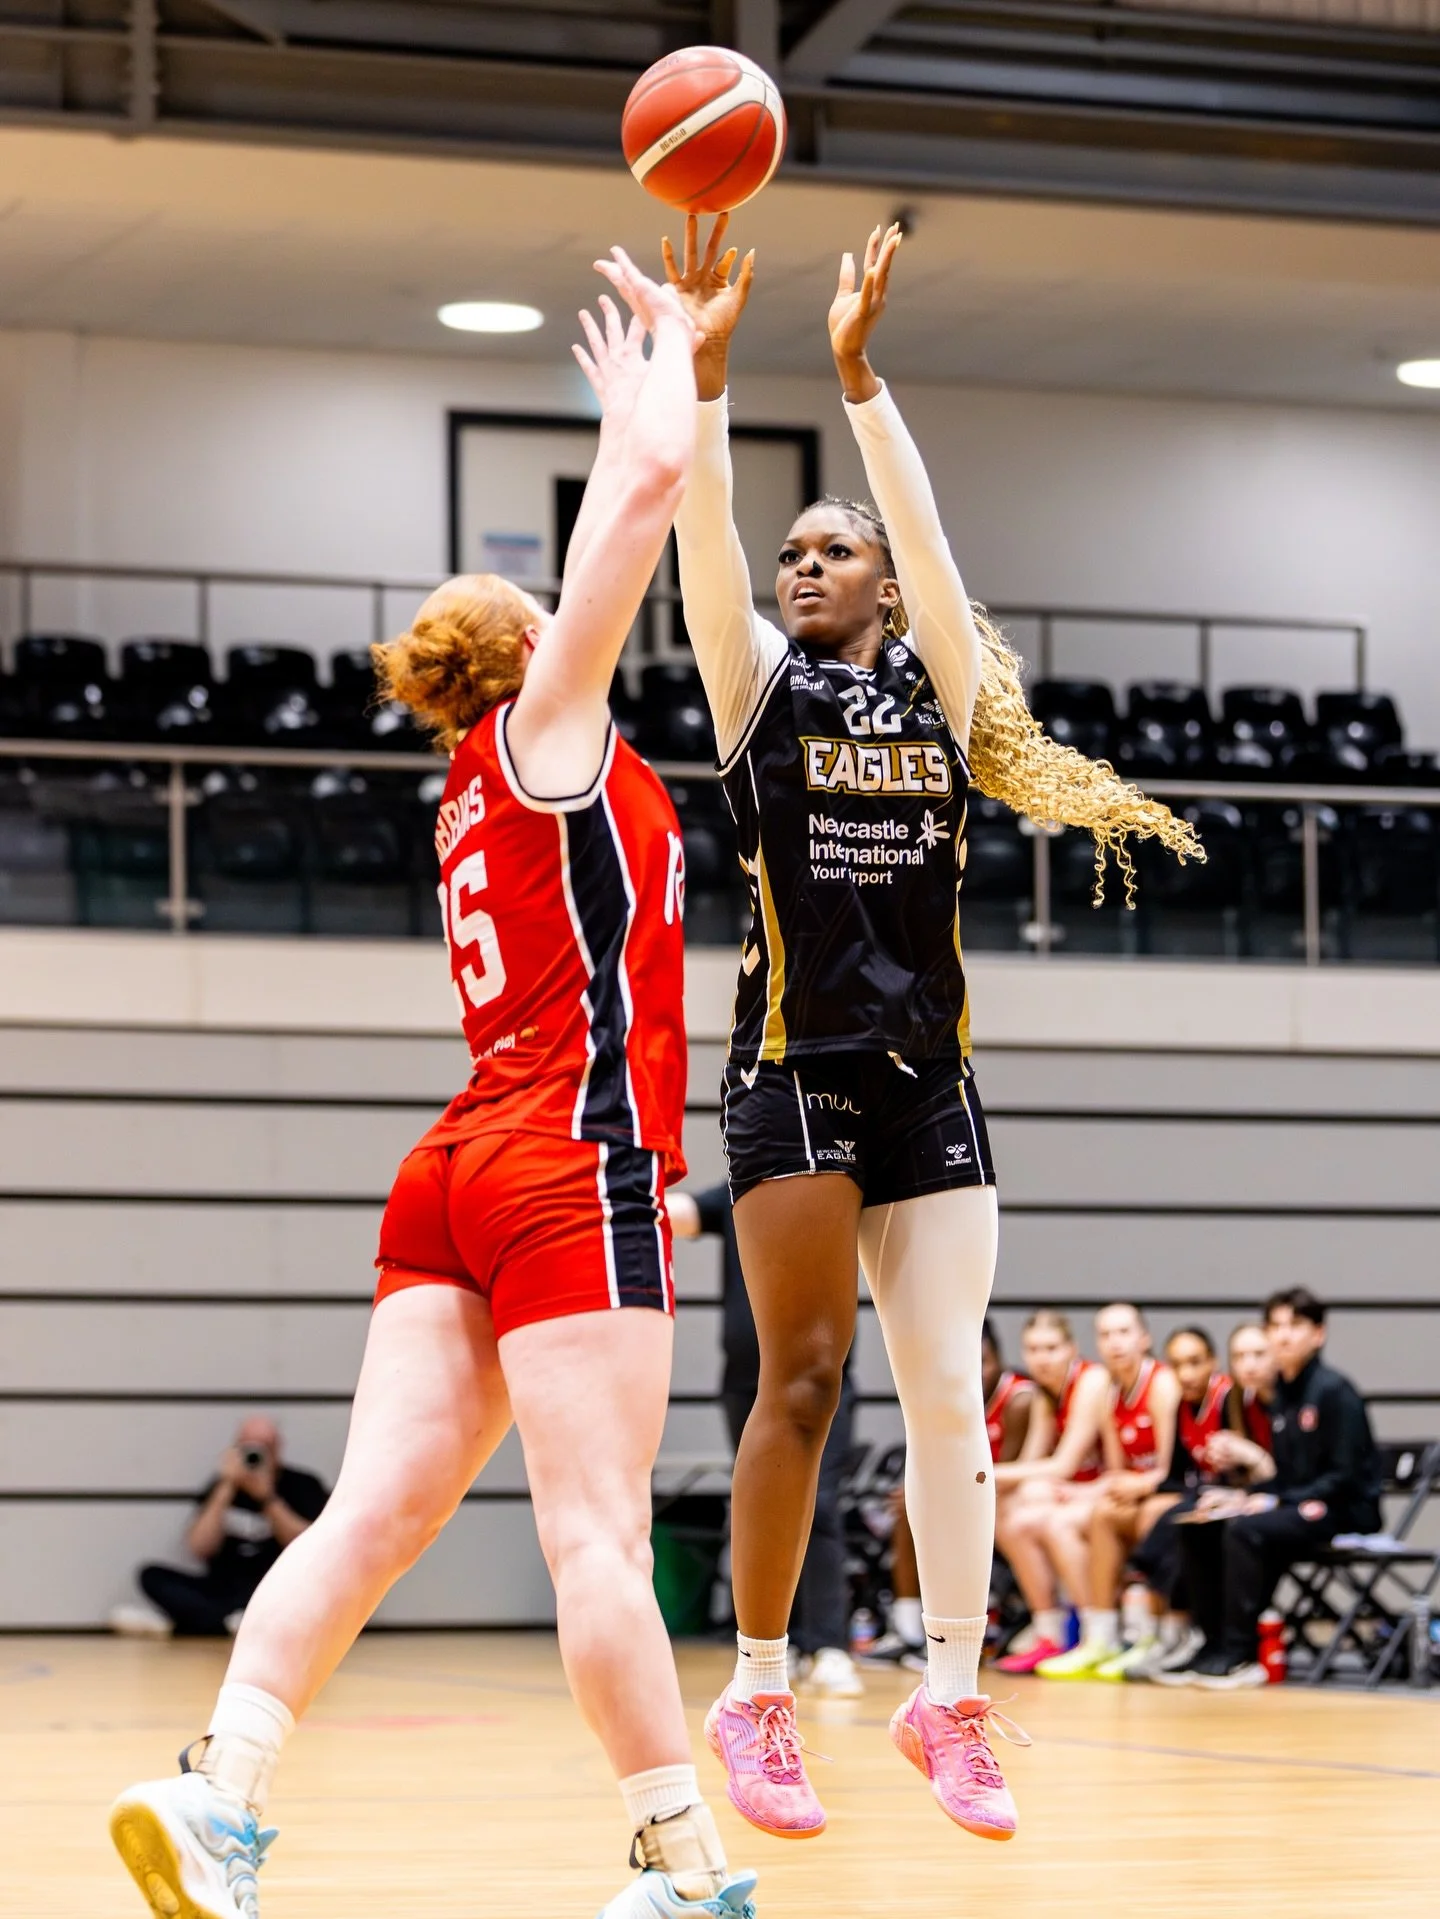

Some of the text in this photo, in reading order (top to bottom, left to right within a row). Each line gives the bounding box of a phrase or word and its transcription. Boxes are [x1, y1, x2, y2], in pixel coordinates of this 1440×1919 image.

[837, 685, 903, 736] 22
[807, 741, 950, 793] EAGLES
[809, 839, 924, 865] Intenational
[810, 865, 893, 887] Your irport
[945, 1156, 972, 1167] hummel
